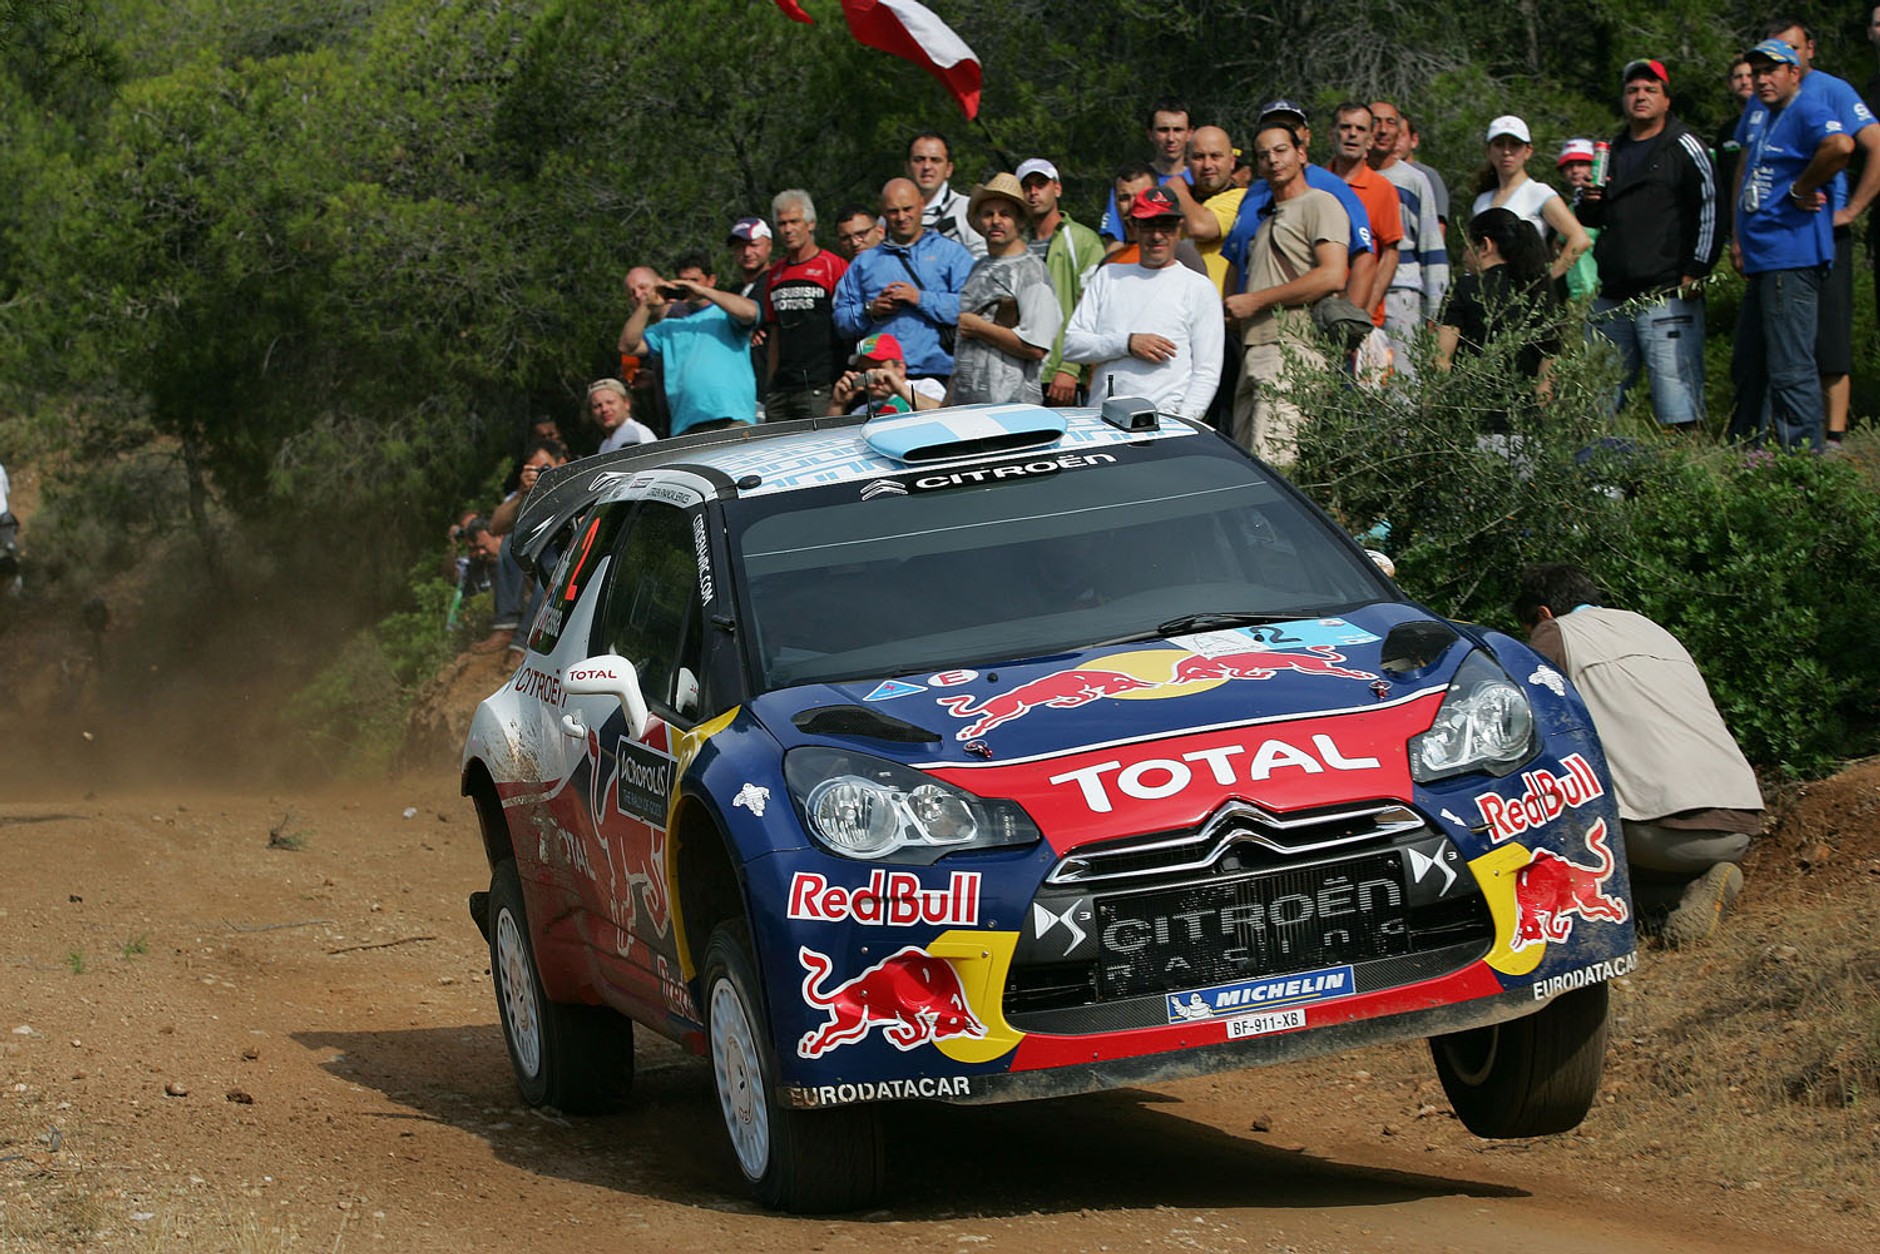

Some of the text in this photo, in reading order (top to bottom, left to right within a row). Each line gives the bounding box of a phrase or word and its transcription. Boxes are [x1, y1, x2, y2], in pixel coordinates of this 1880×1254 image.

[564, 517, 601, 601] 2
[1248, 626, 1303, 653] 2
[569, 669, 618, 682] TOTAL
[620, 750, 667, 798] ACROPOLIS
[1048, 732, 1383, 814] TOTAL
[1214, 971, 1346, 1008] MICHELIN
[1231, 1012, 1301, 1036] BF-911-XB
[789, 1075, 972, 1107] EURODATACAR
